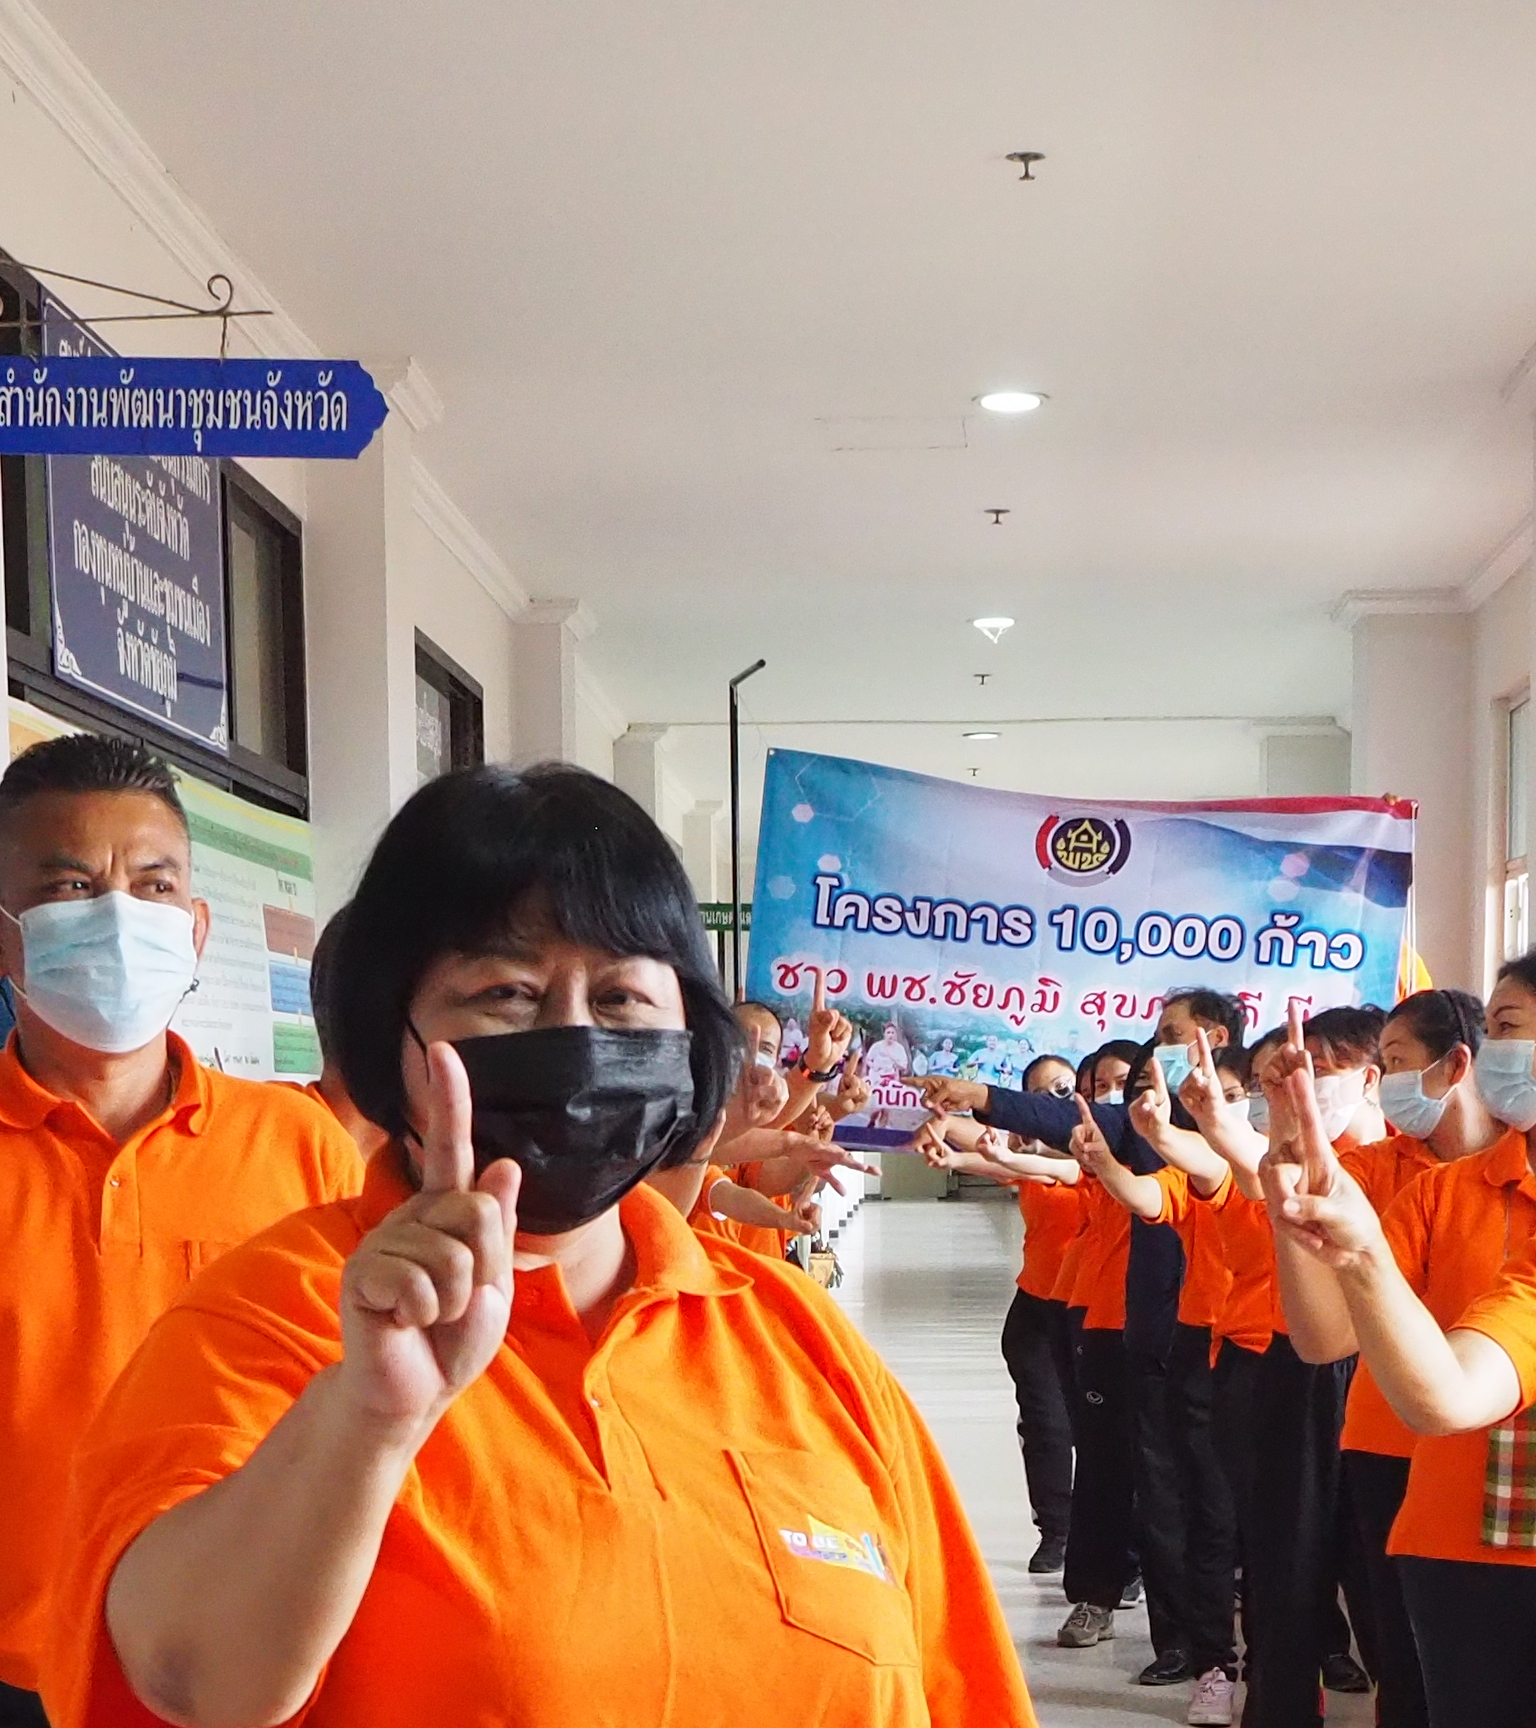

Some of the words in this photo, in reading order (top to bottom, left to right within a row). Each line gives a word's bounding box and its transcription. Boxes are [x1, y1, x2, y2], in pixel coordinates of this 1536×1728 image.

[812, 874, 1035, 947] โครงการ
[1049, 905, 1244, 964] 10,000
[1253, 913, 1365, 971] ก้าว
[778, 1528, 808, 1547] TO
